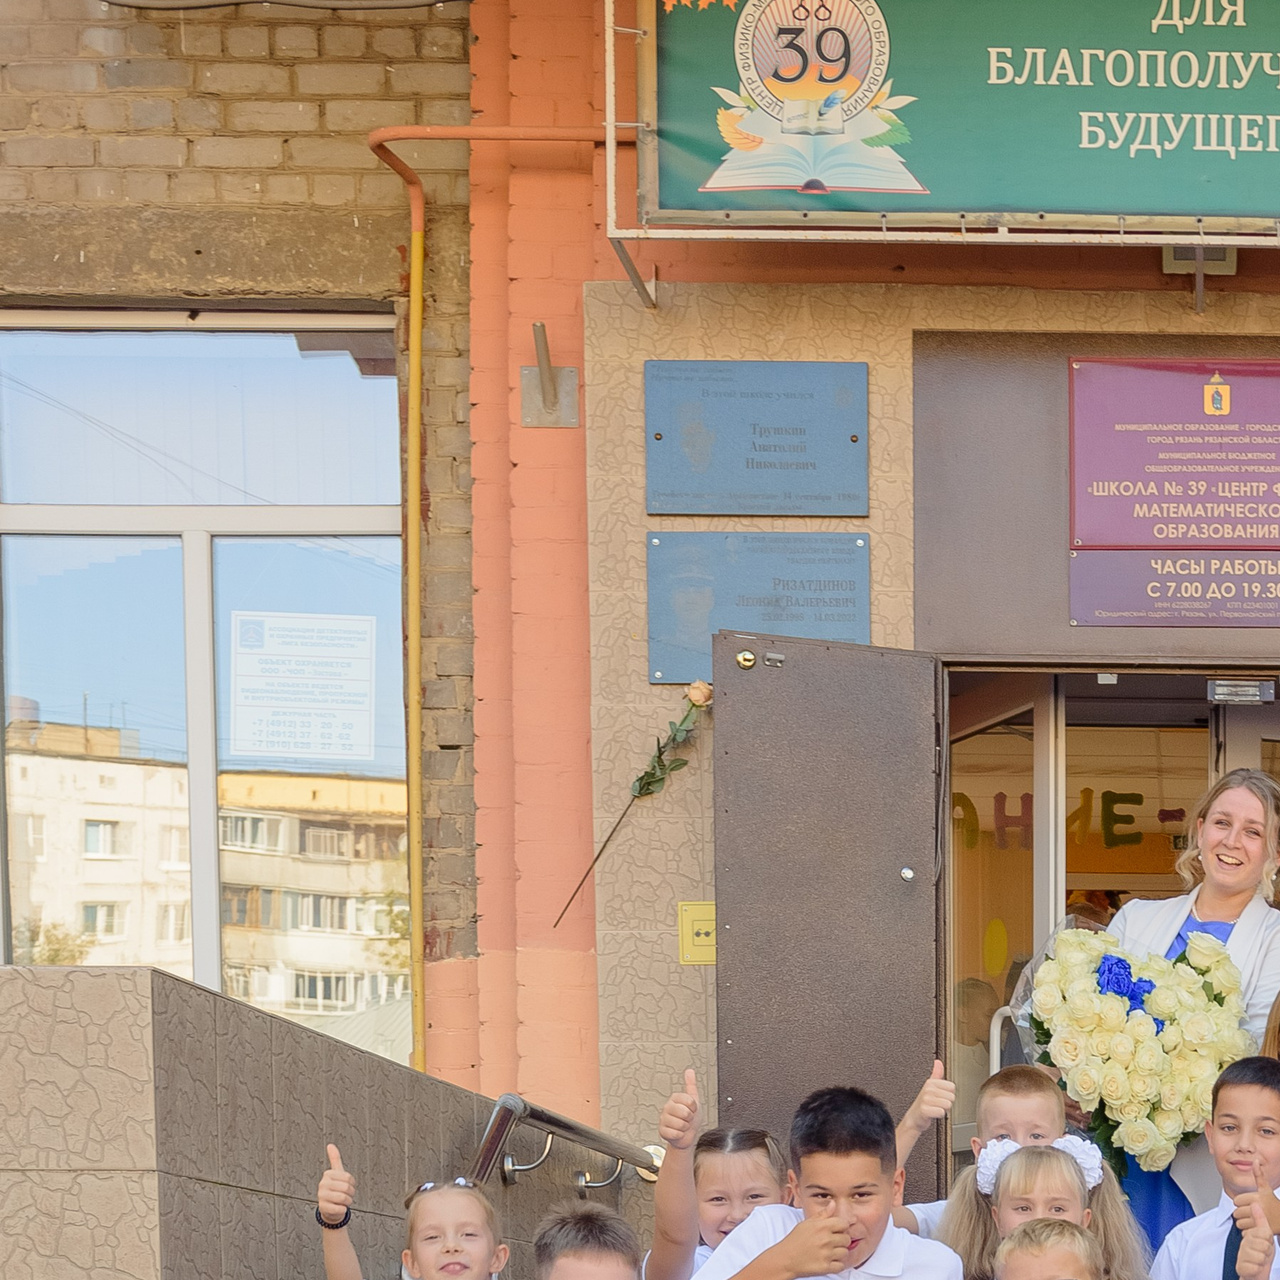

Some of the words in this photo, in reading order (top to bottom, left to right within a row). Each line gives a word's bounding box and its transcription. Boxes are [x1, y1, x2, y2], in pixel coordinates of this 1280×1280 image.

[1151, 0, 1247, 34] ДЛЯ
[737, 0, 769, 73] ФИЗИКО-М
[771, 26, 851, 84] 39
[843, 19, 887, 117] ОБРАЗОВАНИЯ
[745, 76, 783, 117] ЦЕНТР
[749, 422, 807, 438] Трушкин
[1114, 423, 1183, 432] МУНИЦИПАЛЬНОЕ
[1184, 423, 1239, 432] ОБРАЗОВАНИЕ
[1147, 435, 1174, 445] ГОРОД
[1175, 436, 1203, 445] РЯЗАНЬ
[1204, 434, 1250, 445] РЯЗАНСКОЙ
[1158, 451, 1227, 461] МУНИЦИПАЛЬНОЕ
[1227, 452, 1276, 461] БЮДЖЕТНОЕ
[744, 456, 817, 471] Николаевич
[1144, 464, 1240, 474] ОБЩЕОБРАЗОВАТЕЛЬНОЕ
[1164, 481, 1183, 497] №
[1187, 480, 1208, 497] 39
[1150, 558, 1205, 575] ЧАСЫ
[1146, 581, 1161, 598] С
[1166, 581, 1202, 598] 7.00
[1205, 582, 1236, 600] ДО
[1219, 610, 1275, 620] Первомайский
[258, 658, 292, 667] ОБЪЕКТ
[294, 659, 352, 668] ОХРАНЯЕТСЯ
[260, 667, 280, 675] ООО
[277, 681, 310, 690] ОБЪЕКТЕ
[271, 710, 312, 718] ДЕЖУРНАЯ
[252, 718, 264, 727] +7
[252, 729, 264, 738] +7
[299, 731, 312, 739] 37
[252, 739, 264, 748] +7
